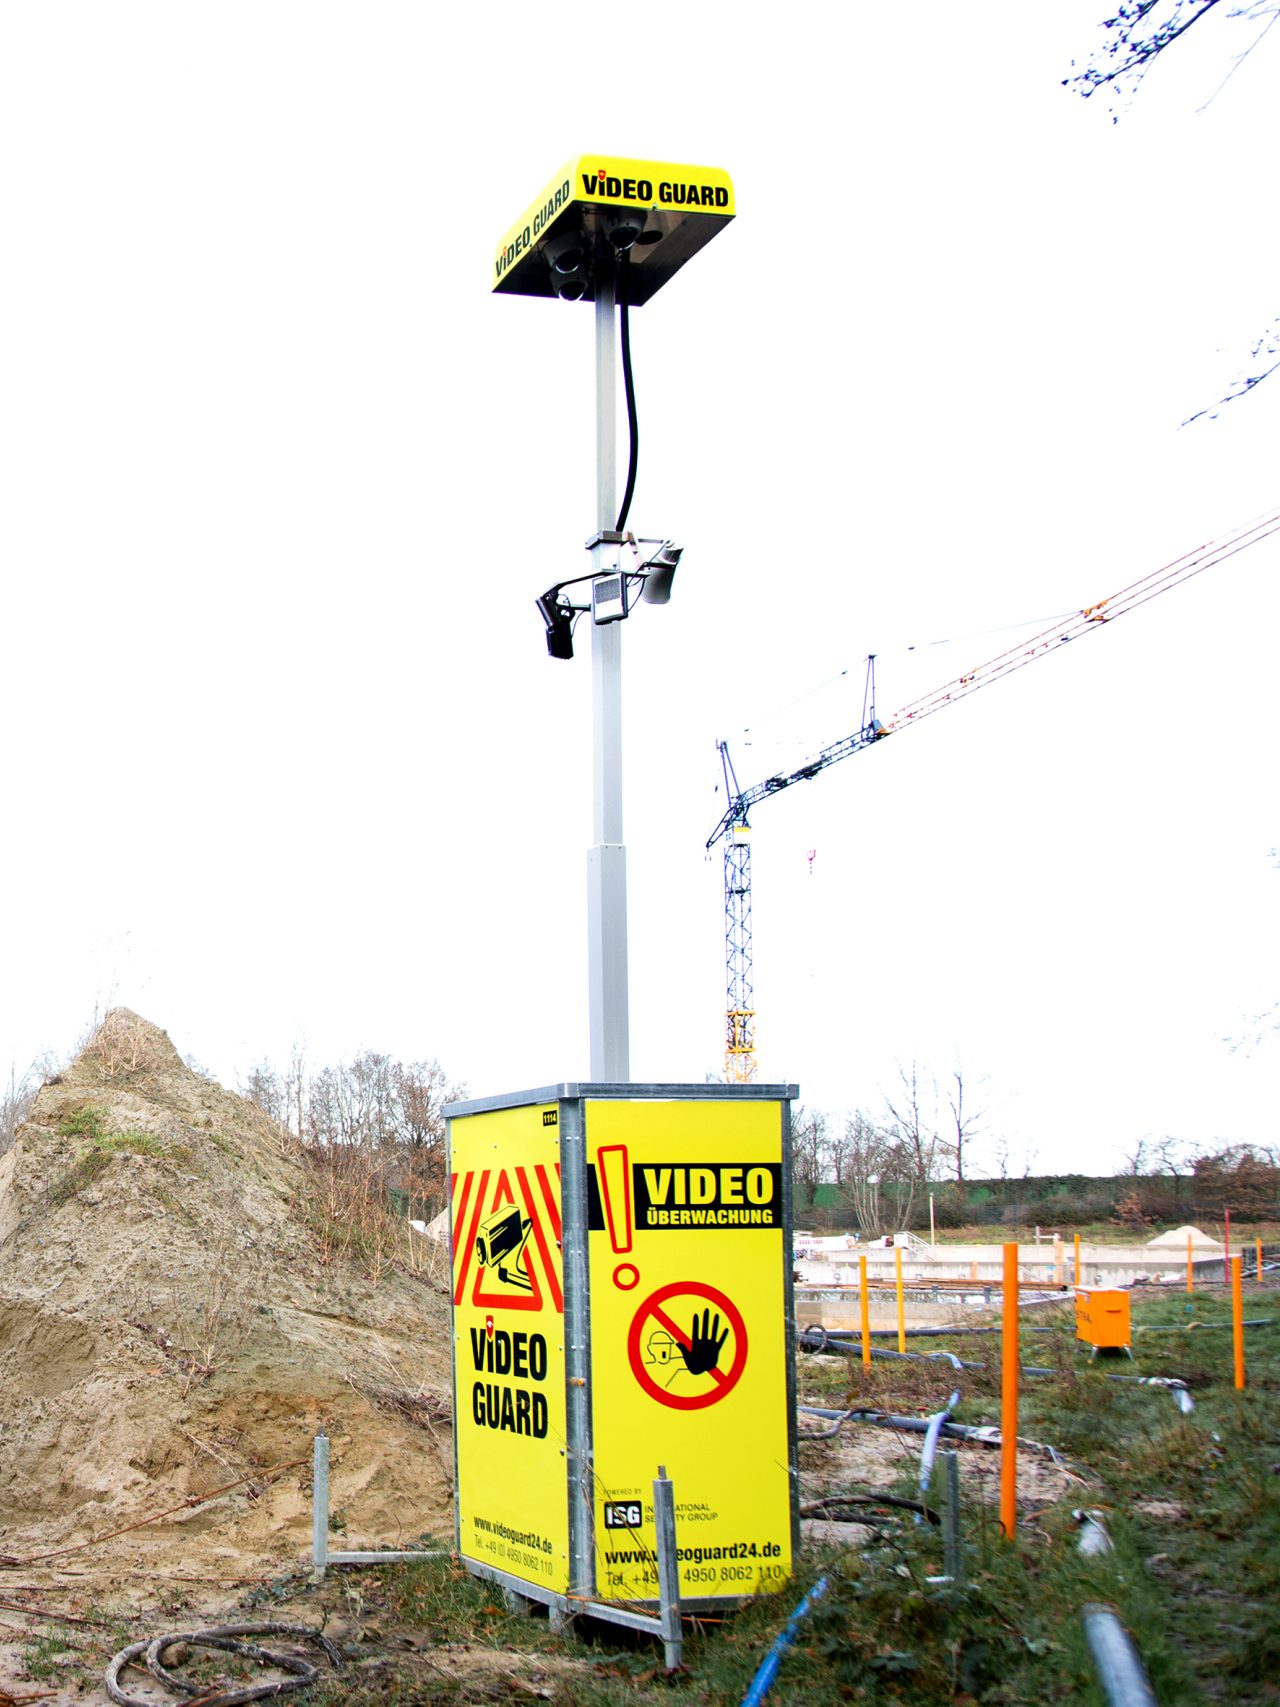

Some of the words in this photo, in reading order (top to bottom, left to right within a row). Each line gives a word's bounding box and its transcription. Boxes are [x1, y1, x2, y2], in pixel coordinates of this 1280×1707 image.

[659, 182, 729, 207] GUARD
[533, 179, 570, 237] GUARD
[643, 1167, 774, 1205] VIDEO
[646, 1207, 774, 1226] ÜBERWACHUNG
[472, 1381, 549, 1440] GUARD
[634, 1488, 642, 1496] BY
[606, 1504, 641, 1525] ISG
[687, 1512, 718, 1522] GROUP
[473, 1516, 553, 1554] www.videoguard24.de
[486, 1540, 497, 1554] +49
[507, 1548, 522, 1564] 4950
[523, 1553, 539, 1570] 8062
[540, 1560, 553, 1576] 110
[605, 1571, 627, 1586] Tel.
[632, 1570, 659, 1585] +49
[683, 1567, 716, 1583] 4950
[720, 1565, 753, 1581] 8062
[758, 1564, 781, 1579] 110
